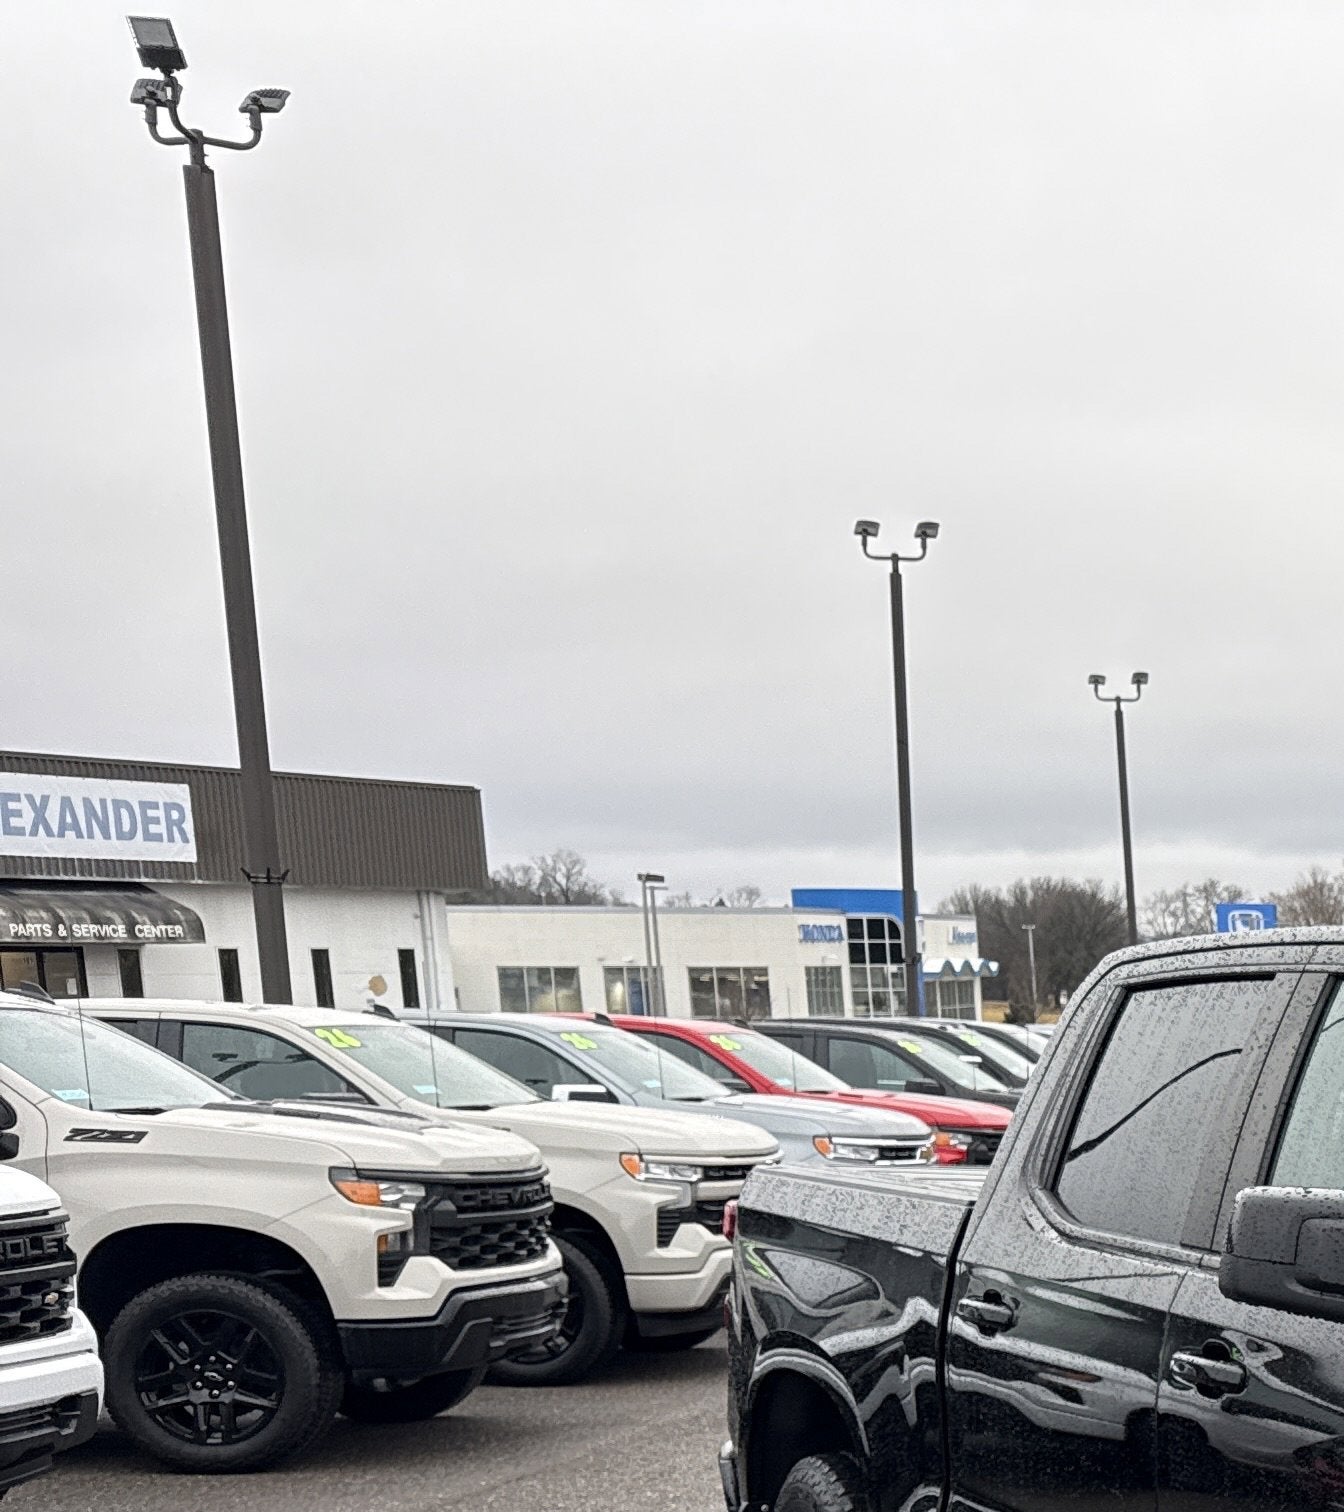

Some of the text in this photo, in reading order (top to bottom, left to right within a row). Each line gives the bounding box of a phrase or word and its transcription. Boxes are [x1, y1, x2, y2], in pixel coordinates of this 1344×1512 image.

[9, 924, 184, 938] PARTS & SERVICE CENTER
